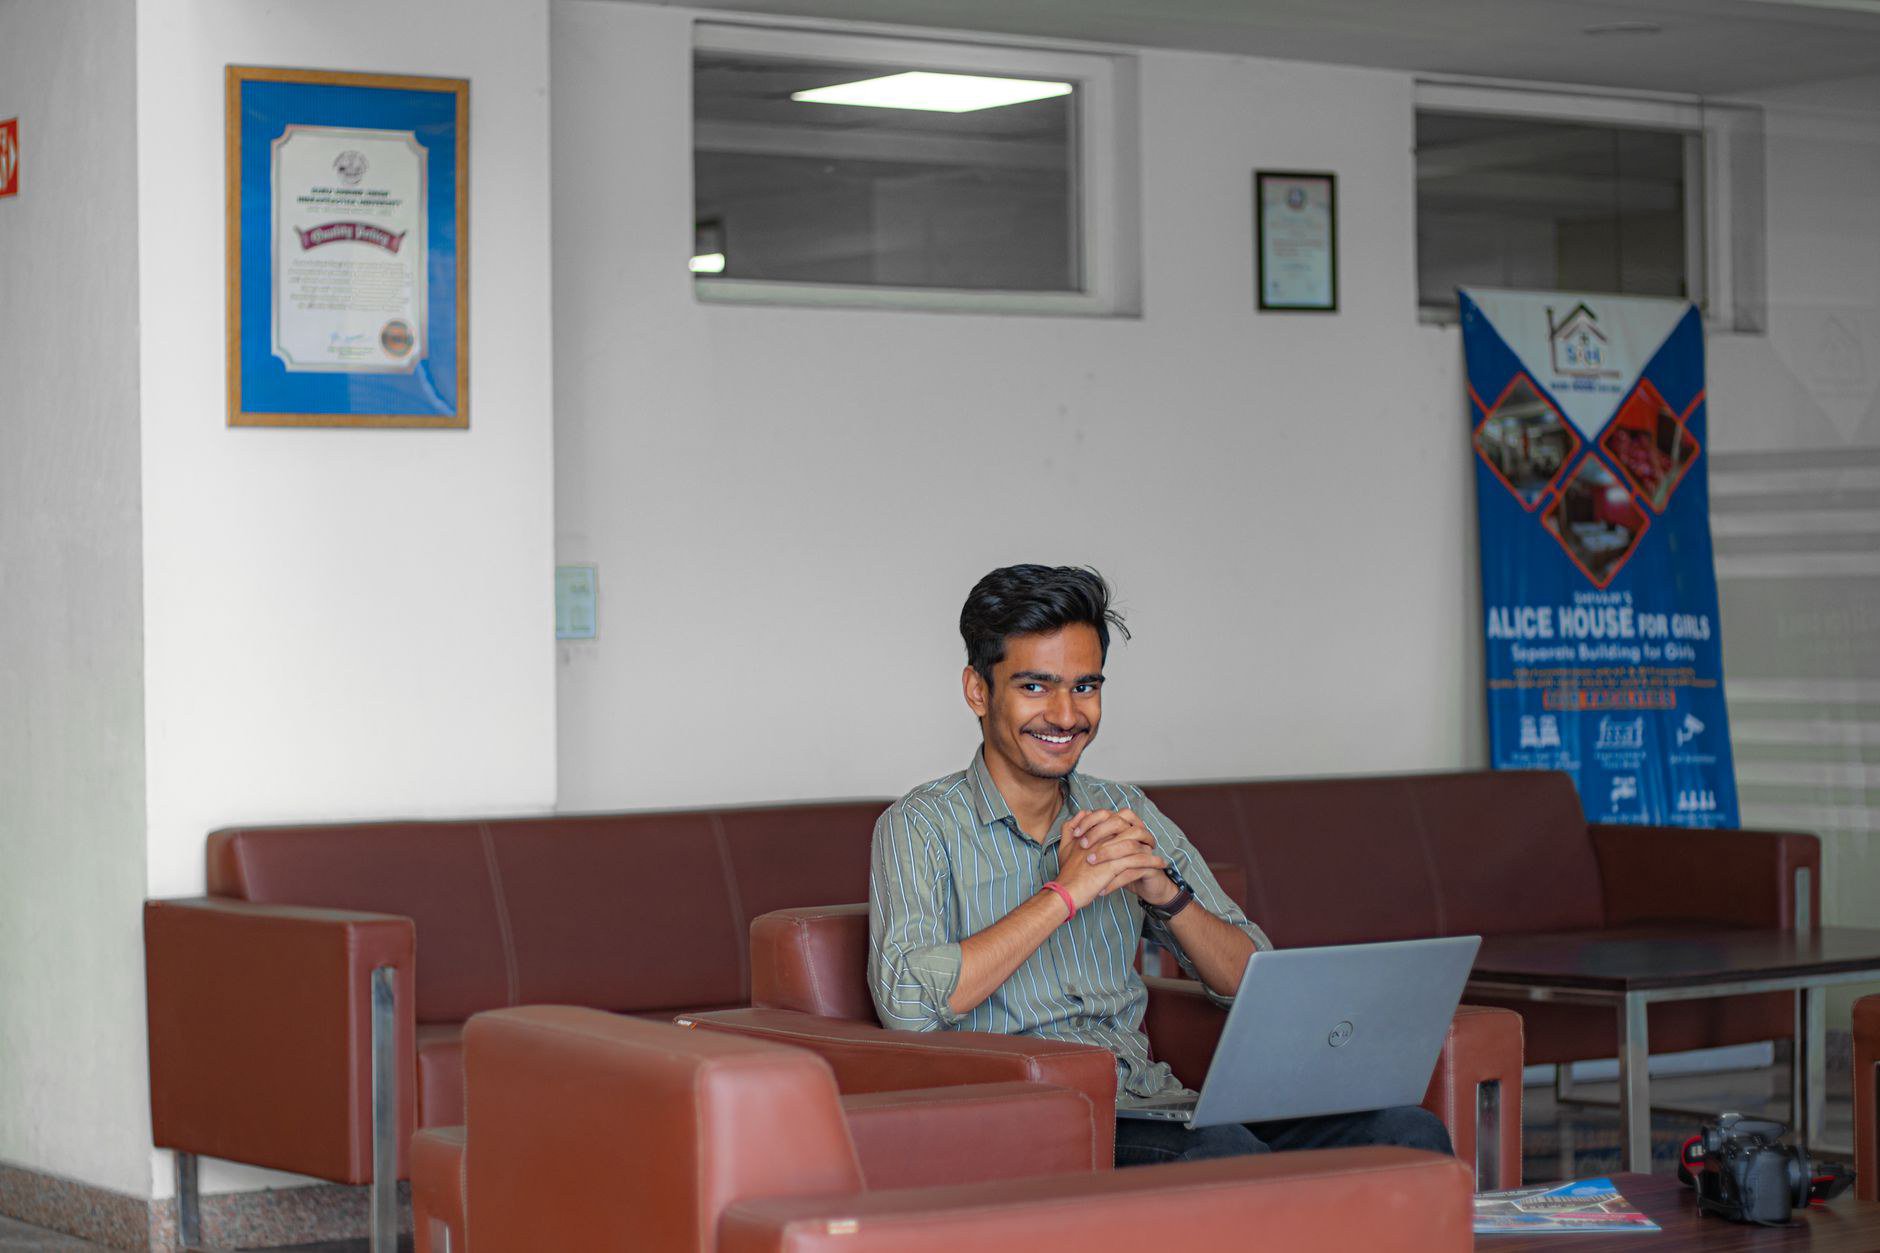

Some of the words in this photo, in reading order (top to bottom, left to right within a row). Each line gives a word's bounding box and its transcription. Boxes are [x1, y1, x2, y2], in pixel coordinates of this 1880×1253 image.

[1488, 606, 1554, 639] ALICE
[1559, 606, 1635, 639] HOUSE
[1638, 613, 1669, 639] FOR
[1672, 614, 1710, 640] GIRLS
[1511, 643, 1576, 662] Separate
[1578, 643, 1641, 662] Building
[1643, 643, 1662, 659] for
[1664, 643, 1696, 661] Girls
